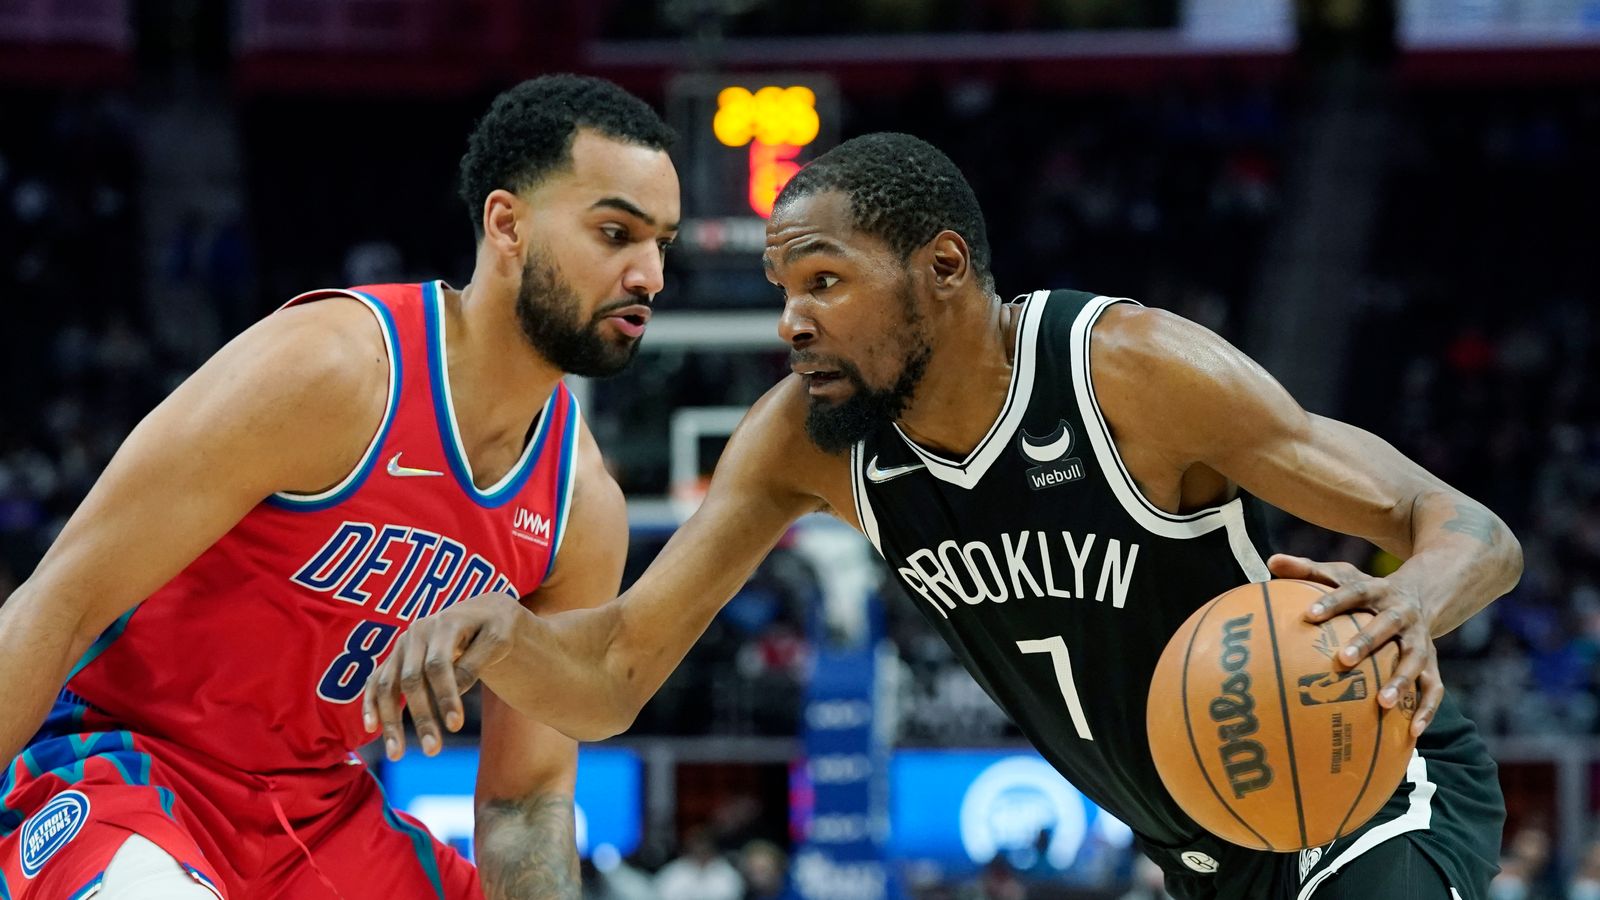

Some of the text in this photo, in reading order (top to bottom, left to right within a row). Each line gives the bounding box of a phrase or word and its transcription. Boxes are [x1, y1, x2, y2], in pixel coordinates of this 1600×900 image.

[1031, 464, 1081, 488] Webull
[513, 506, 551, 540] UWM
[289, 521, 520, 621] DETRO
[316, 619, 400, 703] 8
[1015, 635, 1094, 741] 7
[1208, 612, 1275, 799] Wilson
[1331, 713, 1342, 728] BALL
[28, 806, 69, 847] DETROIT
[30, 815, 71, 859] PISTONS
